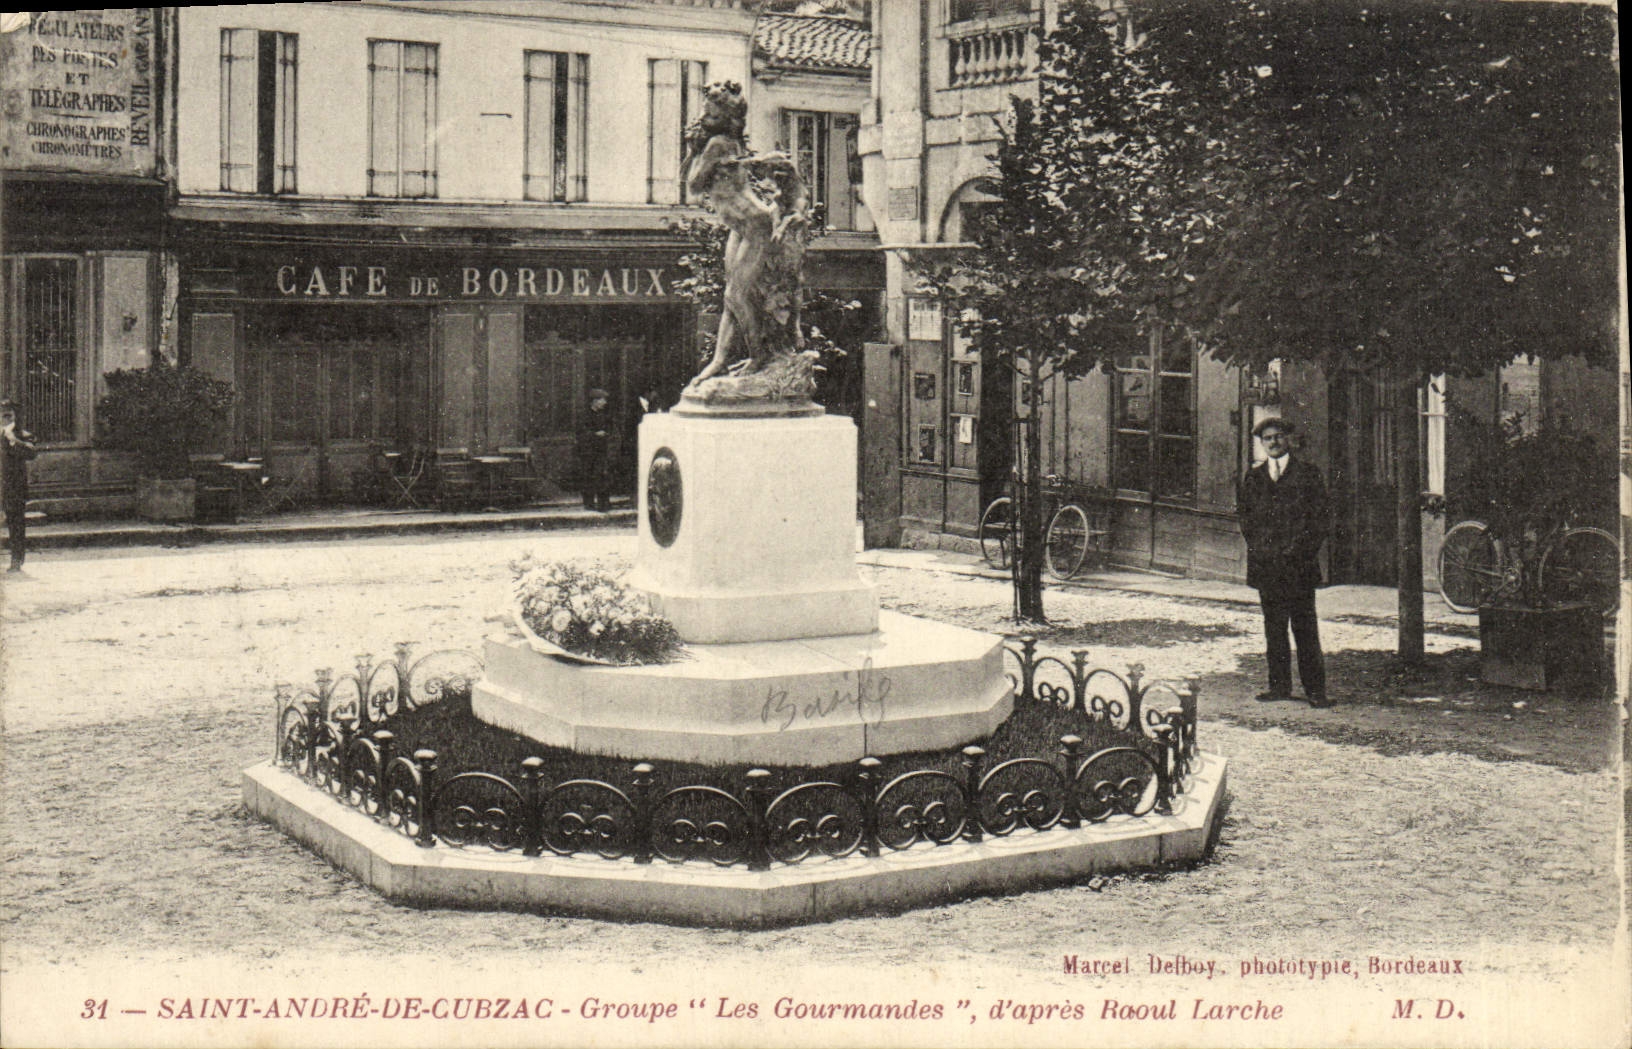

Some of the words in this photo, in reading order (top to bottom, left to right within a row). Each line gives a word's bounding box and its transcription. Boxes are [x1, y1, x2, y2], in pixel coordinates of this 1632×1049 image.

[65, 72, 89, 86] ET
[28, 85, 127, 113] TÉLÉGRAPHES
[26, 121, 126, 142] CHRONOGRAPHES
[276, 265, 387, 297] CAFE
[410, 276, 439, 297] DE
[460, 267, 666, 297] BORDEAUX
